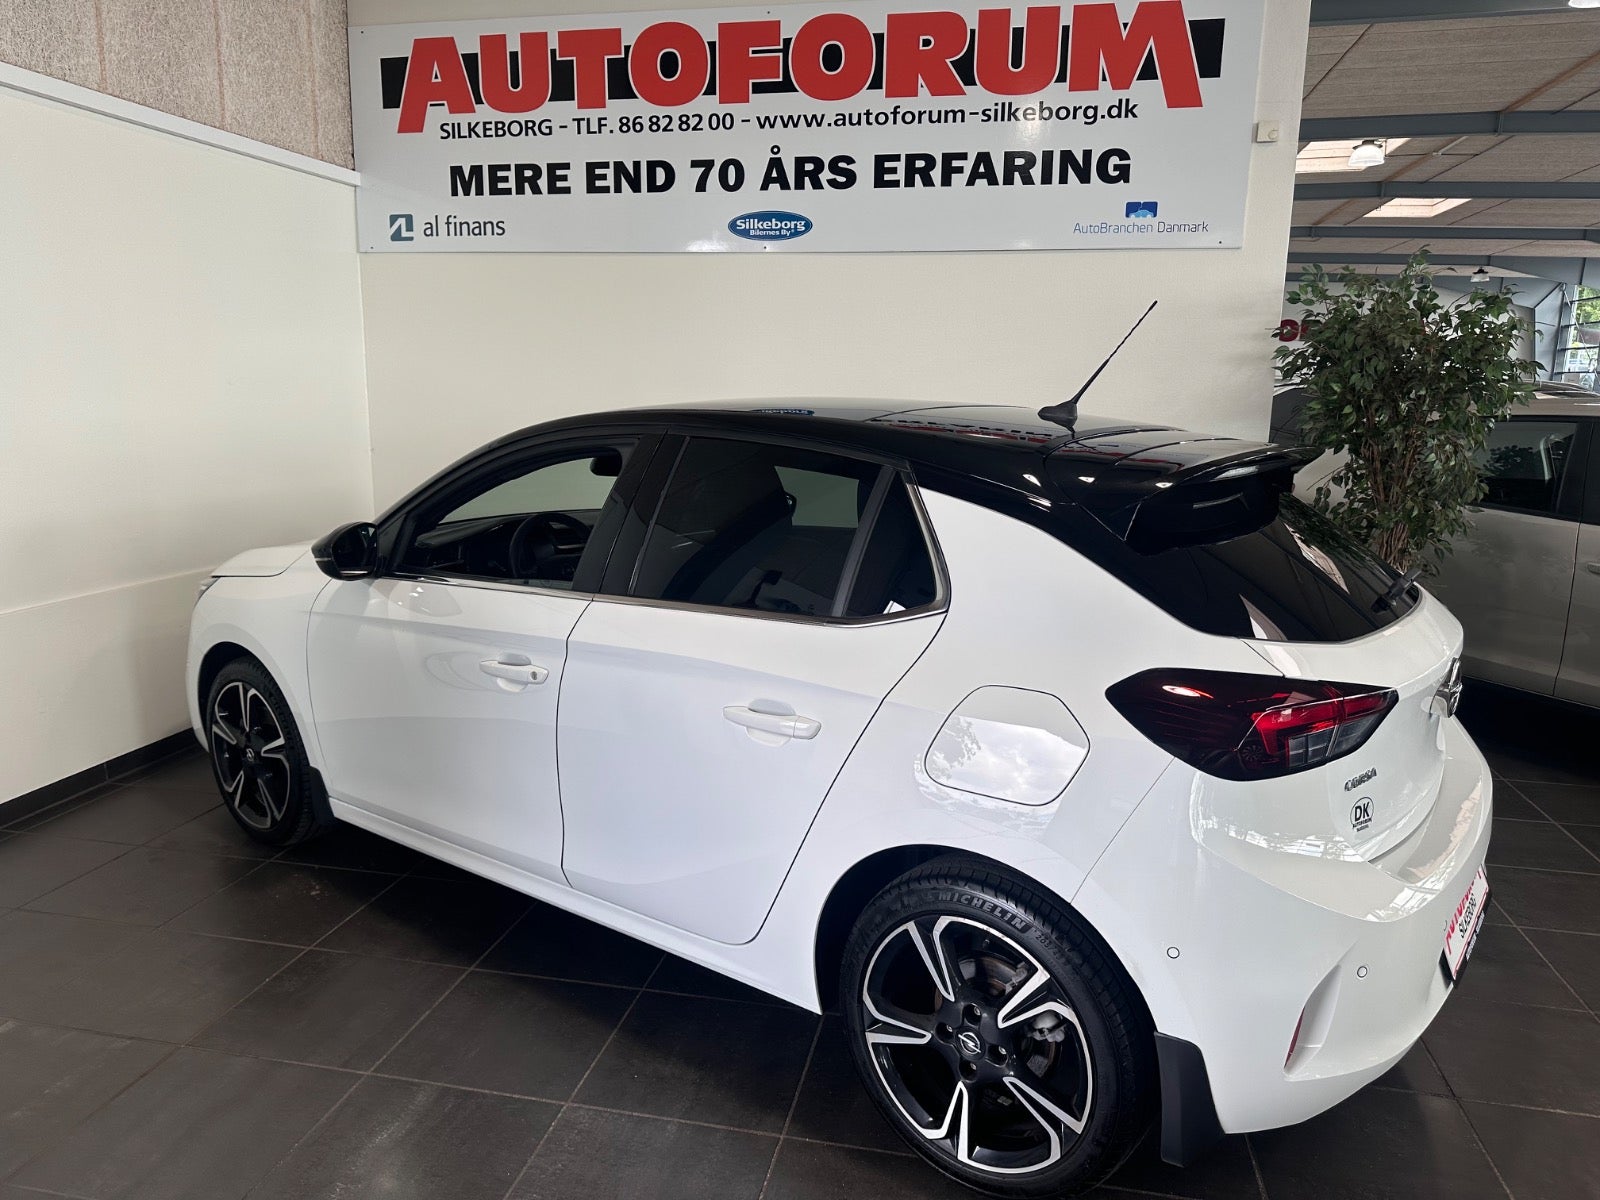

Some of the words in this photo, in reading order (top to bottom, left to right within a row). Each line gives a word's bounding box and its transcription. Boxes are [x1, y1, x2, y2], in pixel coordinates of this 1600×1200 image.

[397, 0, 1204, 135] AUTOFORUM
[440, 119, 553, 140] SILKEBORG
[572, 117, 614, 135] TLF.
[756, 98, 1139, 130] www.autoforum-silkeborg.dk
[449, 162, 572, 197] MERE
[585, 160, 676, 195] END
[690, 158, 746, 193] 70
[759, 145, 858, 192] ÅRS
[873, 148, 1132, 189] ERFARING
[423, 215, 440, 237] al
[445, 214, 506, 237] finans
[736, 218, 806, 232] Silkeborg
[1073, 222, 1154, 234] AutoBranchen
[1157, 220, 1209, 233] Danmark
[1354, 801, 1370, 822] DK
[938, 890, 1029, 930] MICHELIN
